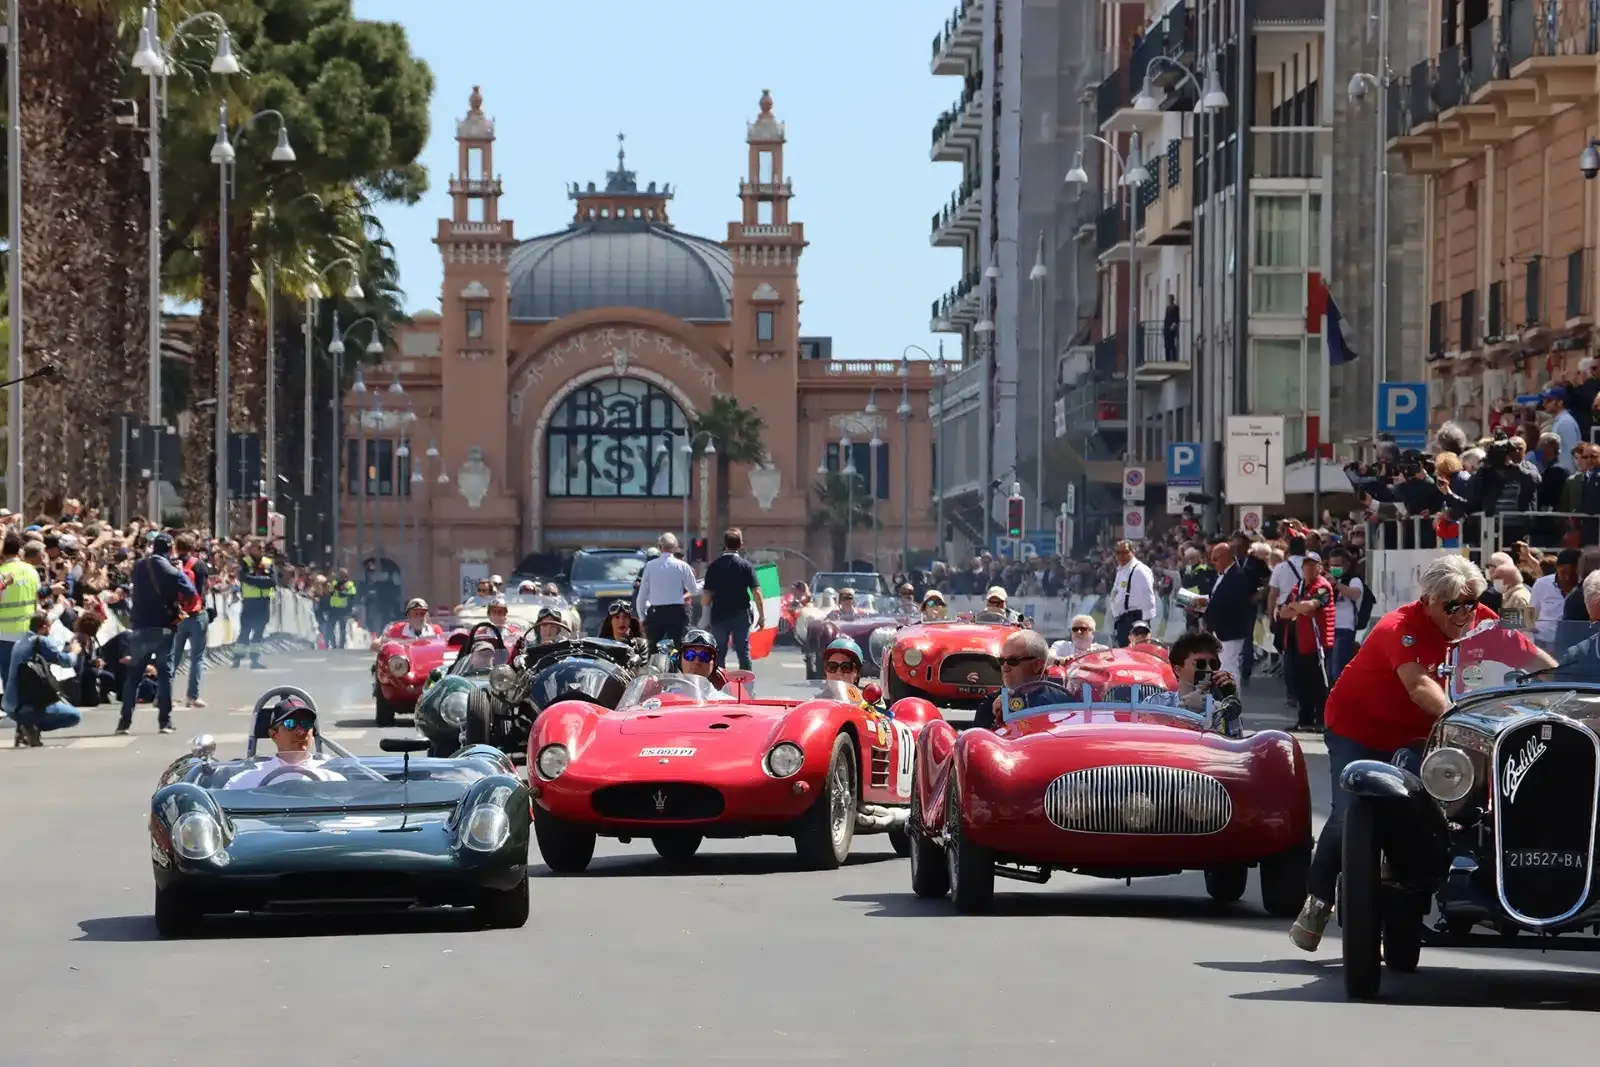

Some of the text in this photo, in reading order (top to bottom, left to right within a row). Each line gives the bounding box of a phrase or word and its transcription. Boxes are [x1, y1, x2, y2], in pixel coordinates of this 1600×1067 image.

[568, 385, 672, 439] Ban
[1387, 387, 1418, 427] P
[1173, 446, 1194, 475] P
[1502, 735, 1547, 804] Balilla
[1510, 852, 1558, 867] 213527
